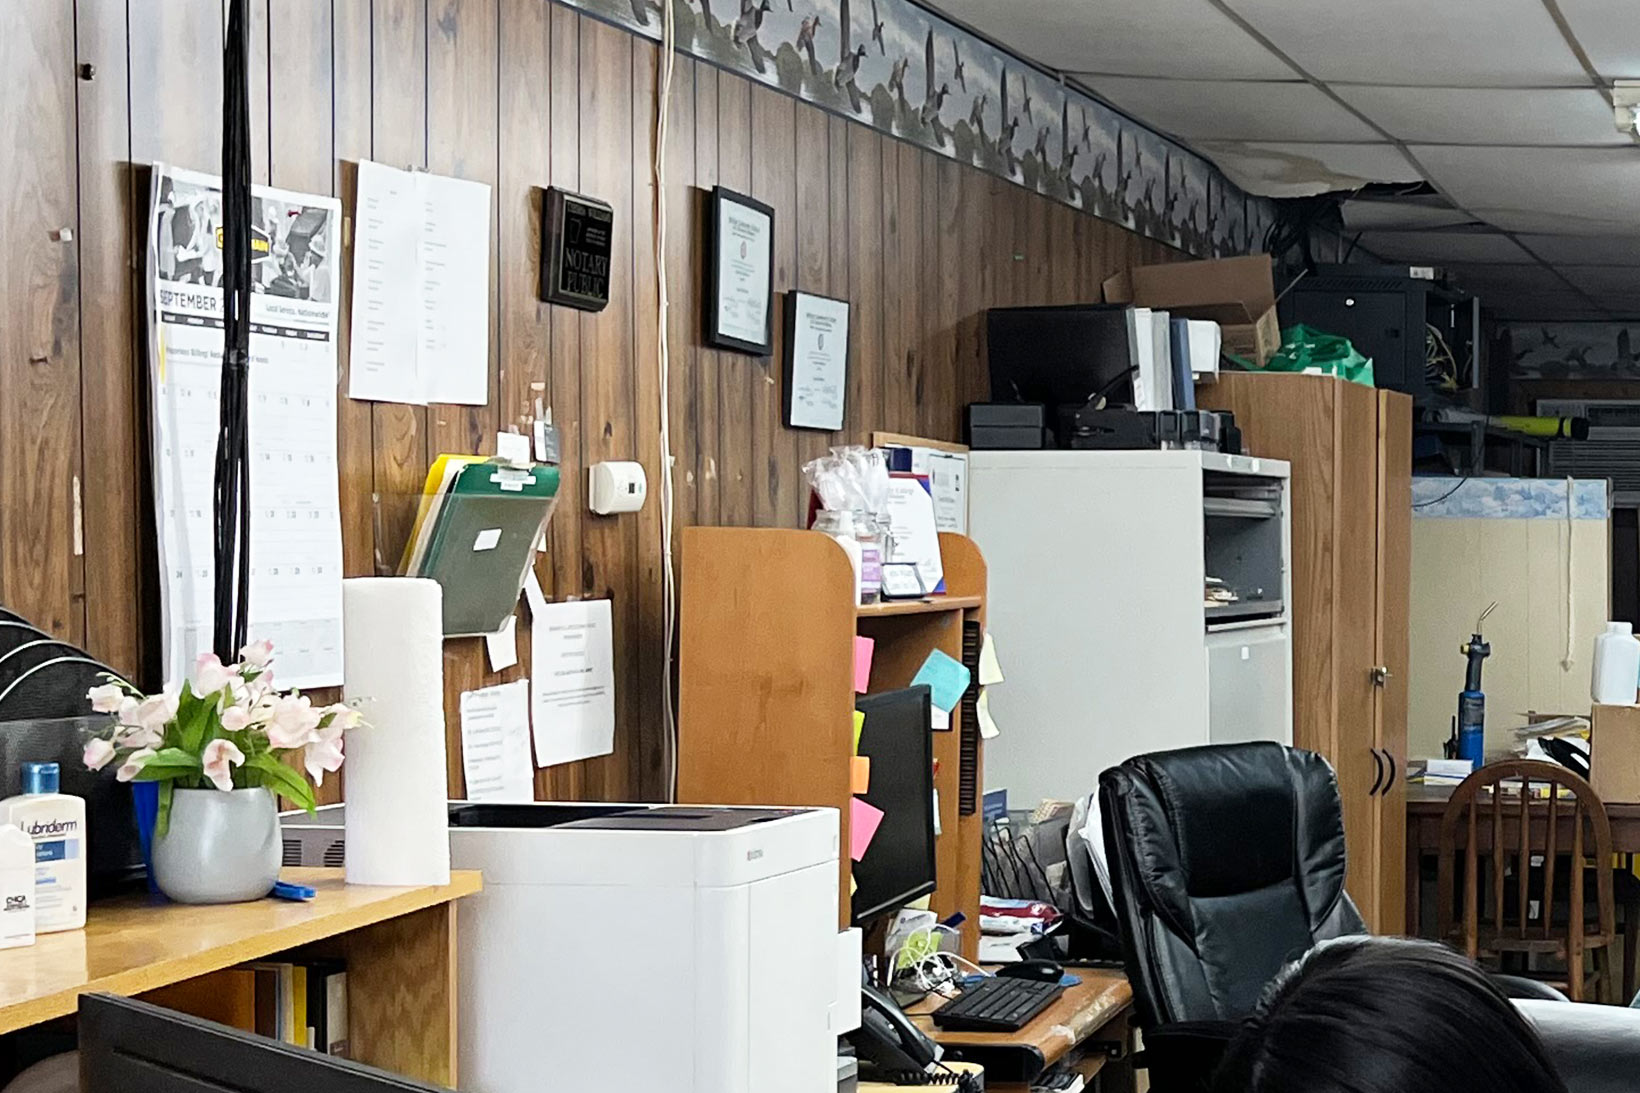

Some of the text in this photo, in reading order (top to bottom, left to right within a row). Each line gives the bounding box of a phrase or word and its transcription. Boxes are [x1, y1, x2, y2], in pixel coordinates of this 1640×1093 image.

[565, 247, 608, 277] NOTARY
[160, 289, 217, 310] SEPTEMBER
[20, 818, 78, 835] Lubriderm
